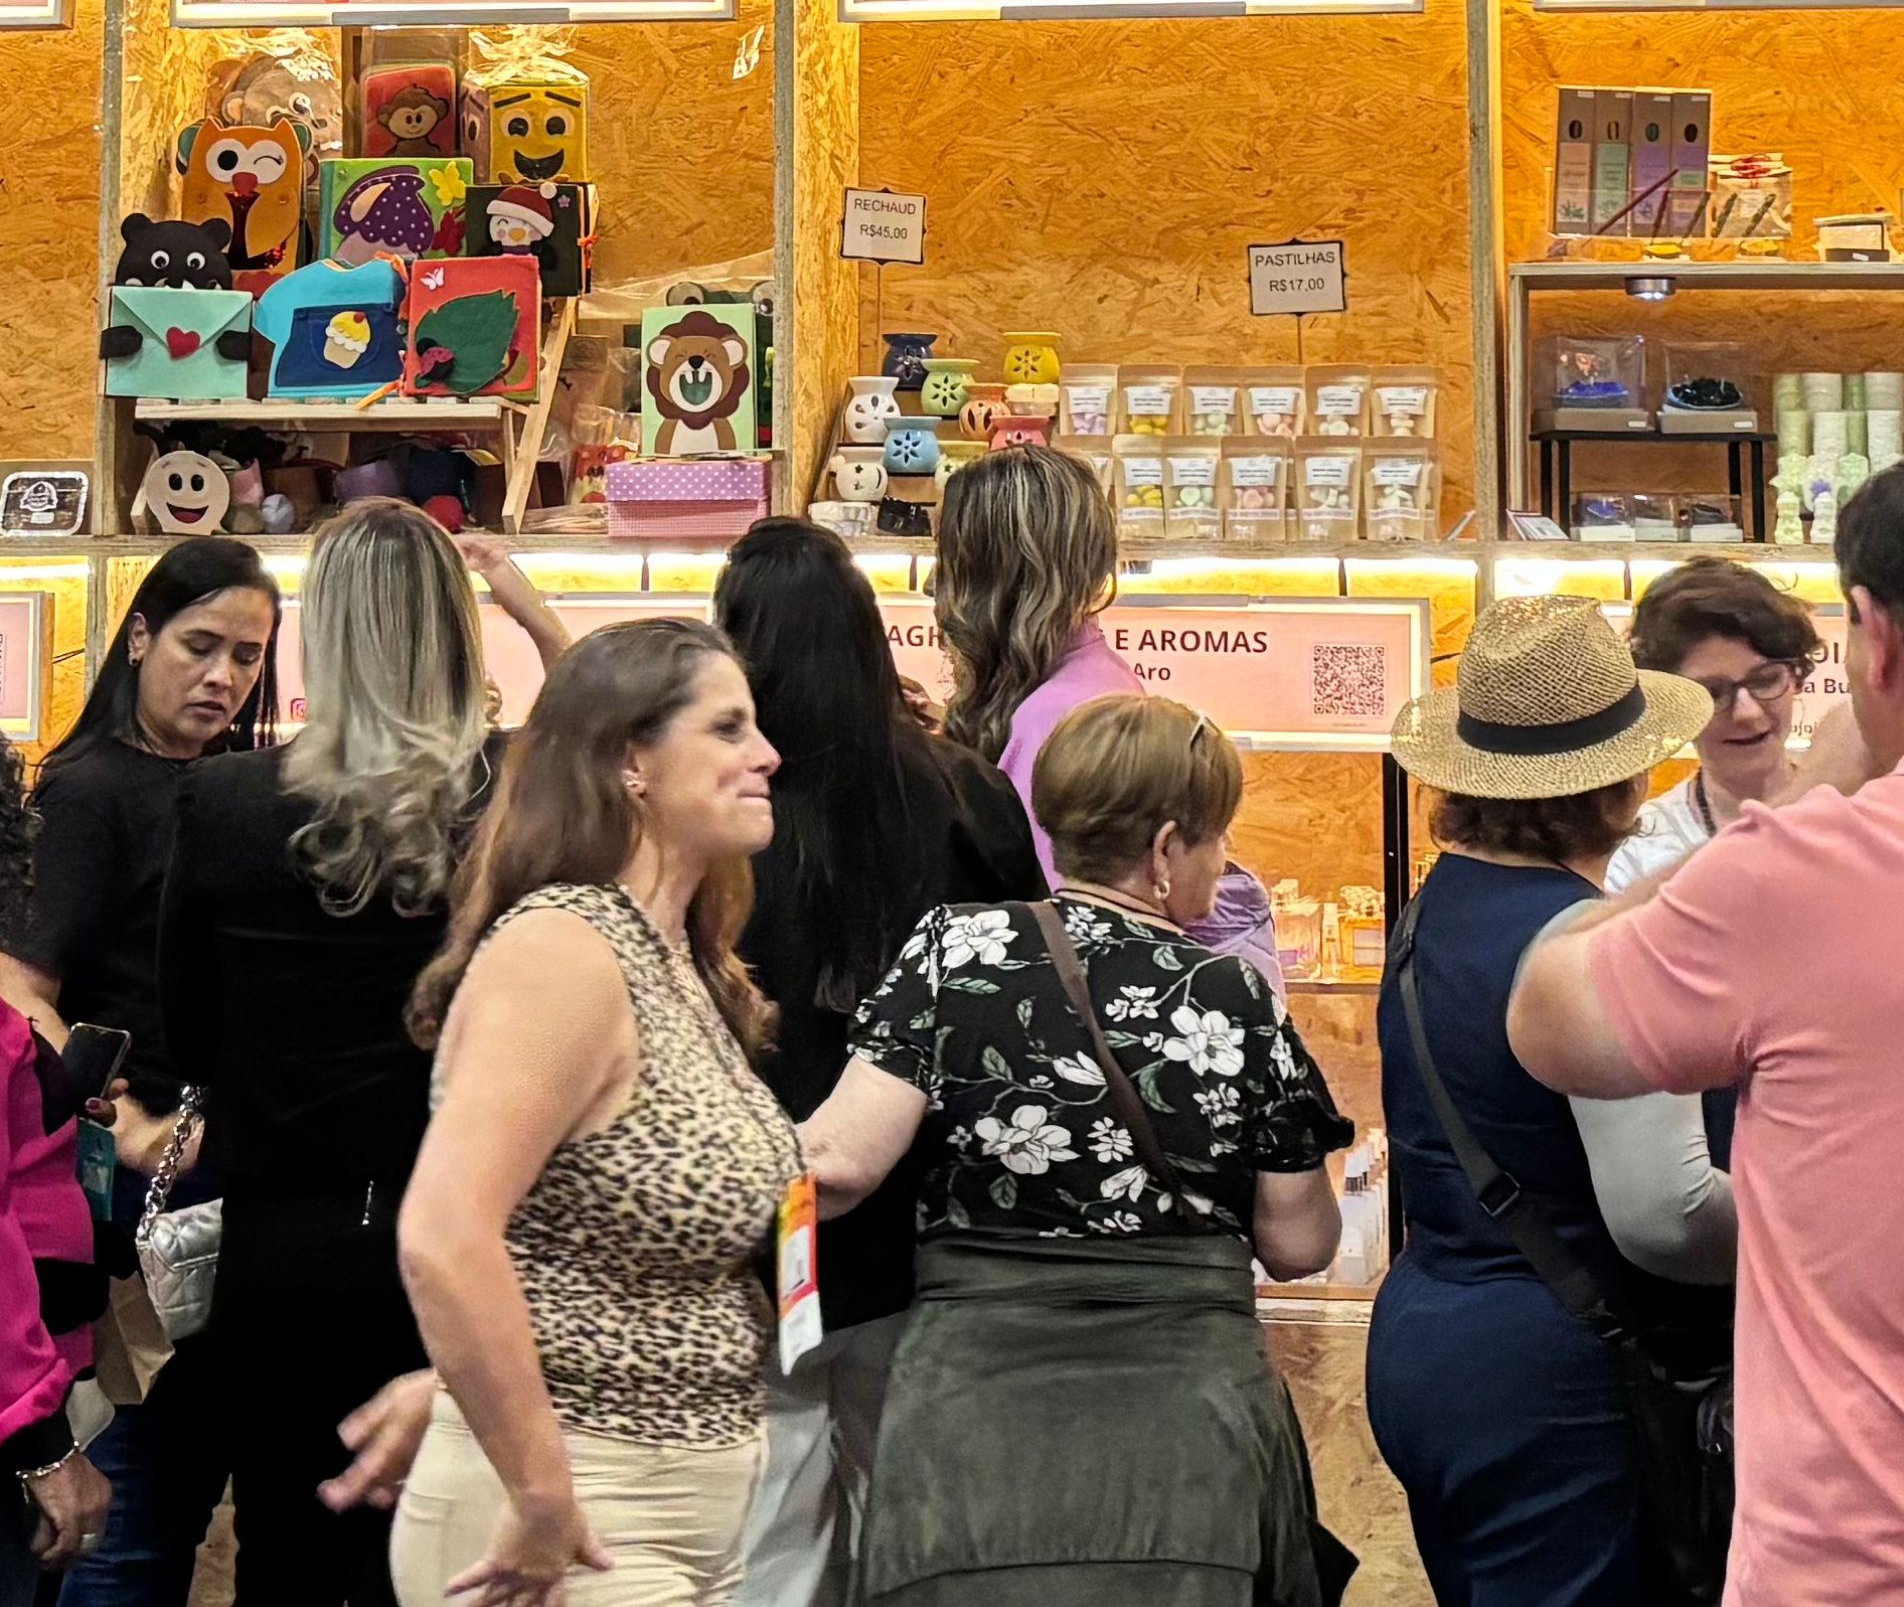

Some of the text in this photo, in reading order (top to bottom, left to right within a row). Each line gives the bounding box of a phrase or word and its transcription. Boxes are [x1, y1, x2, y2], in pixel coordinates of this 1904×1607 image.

[853, 197, 917, 216] RECHAUD
[1255, 251, 1336, 268] PASTILHAS
[1115, 628, 1129, 651] E
[1137, 629, 1268, 654] AROMAS
